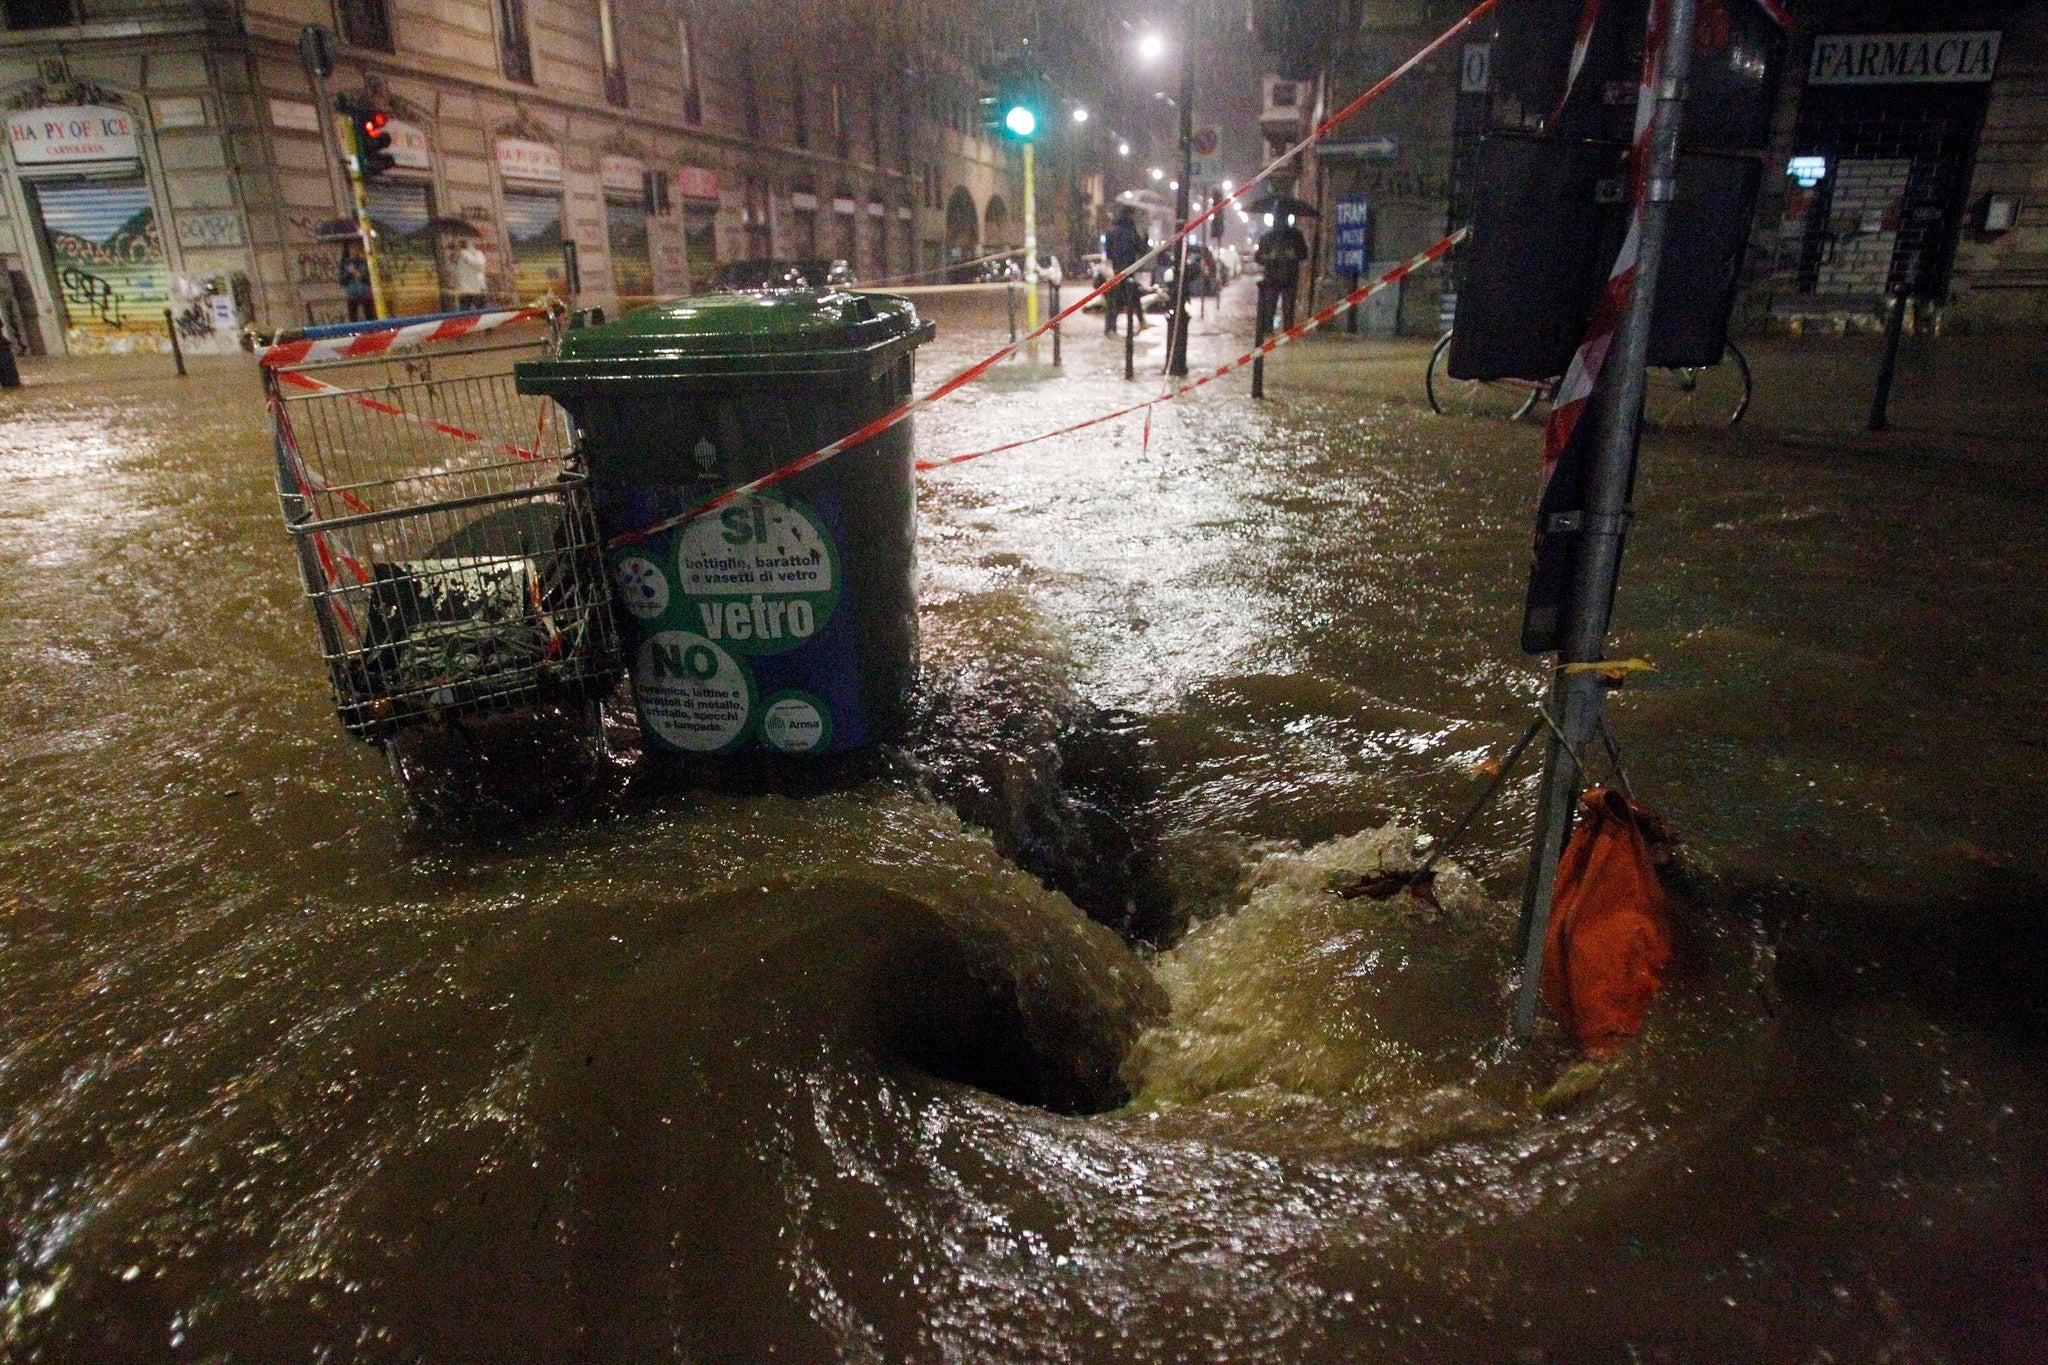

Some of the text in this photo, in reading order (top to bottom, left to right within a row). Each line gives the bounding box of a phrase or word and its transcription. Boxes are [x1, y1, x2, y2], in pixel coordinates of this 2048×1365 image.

[1815, 39, 1991, 75] FARMACIA
[685, 554, 820, 571] bottiglie, barattoli
[692, 569, 818, 583] e vasetti di vetro
[699, 595, 815, 641] vetro
[652, 642, 719, 680] NO
[692, 687, 729, 699] lattine
[731, 690, 739, 699] e
[684, 697, 694, 708] di
[697, 701, 744, 711] metallo,
[694, 711, 738, 721] specchi
[789, 721, 819, 729] Amsa
